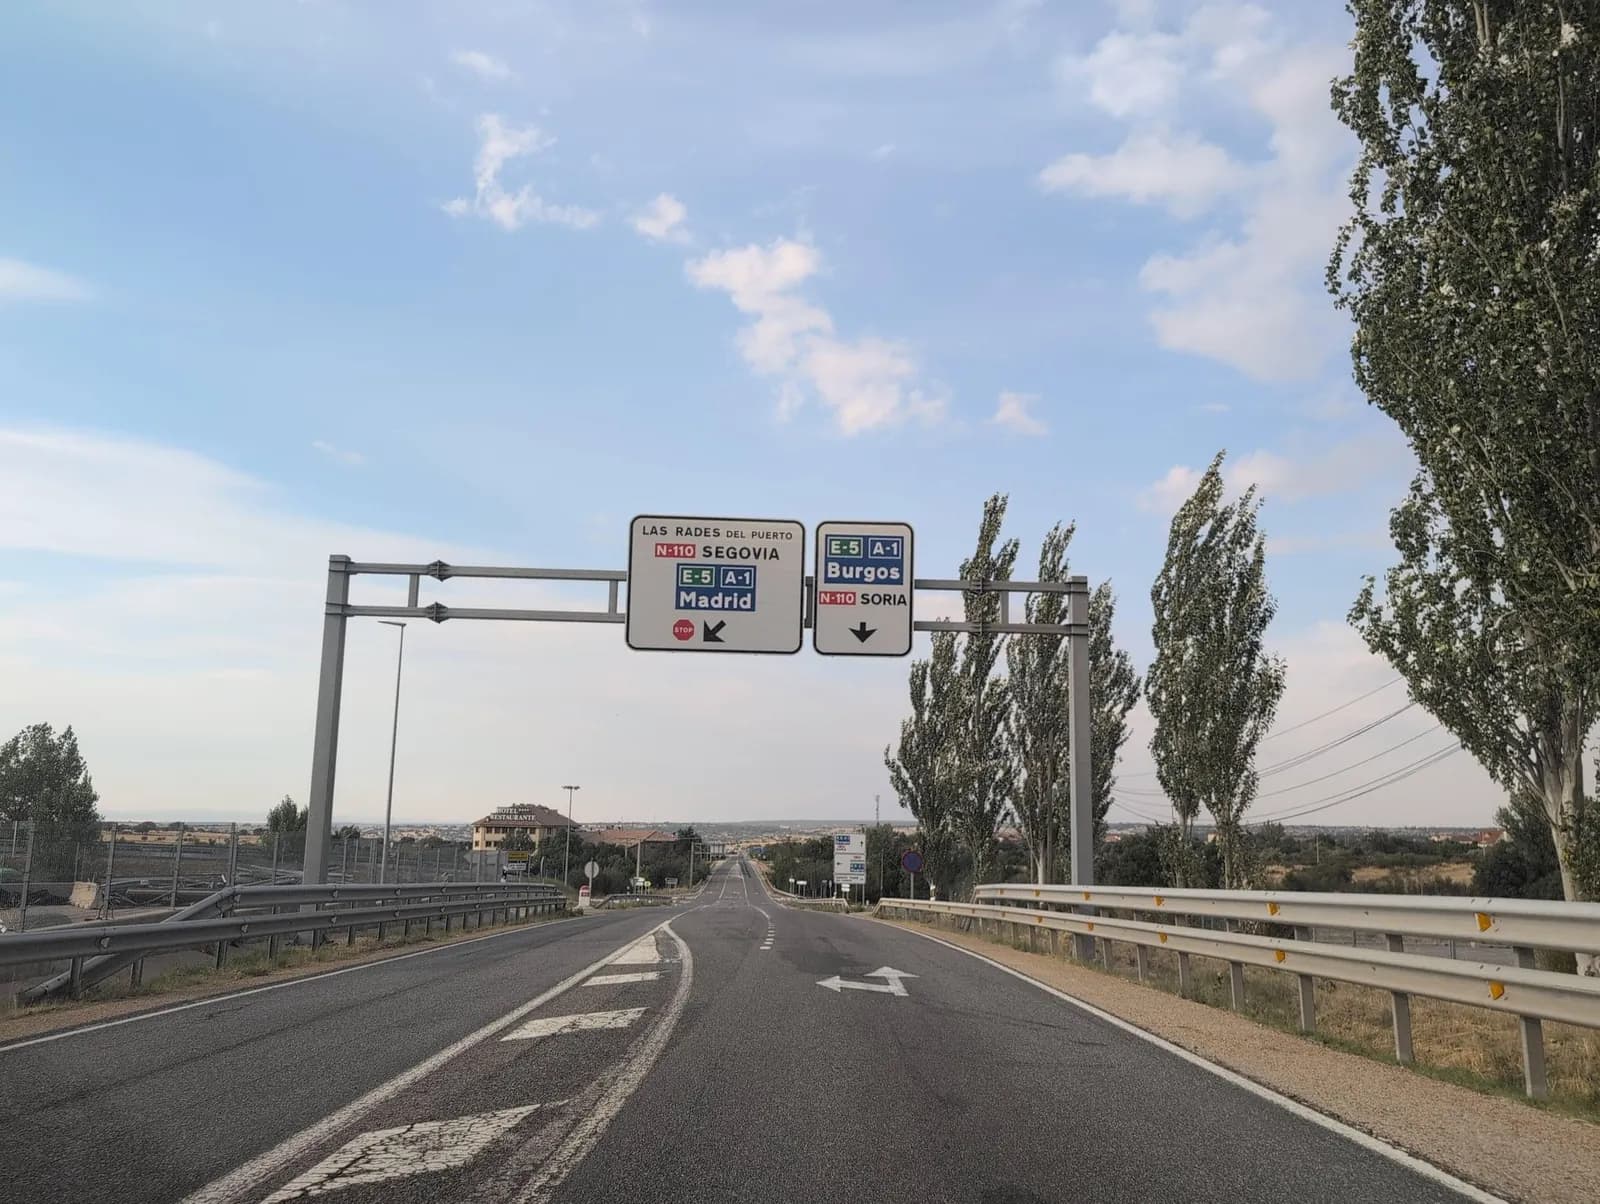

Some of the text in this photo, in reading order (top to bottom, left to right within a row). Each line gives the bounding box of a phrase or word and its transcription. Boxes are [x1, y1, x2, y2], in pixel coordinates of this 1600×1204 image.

[642, 525, 793, 540] LAS RADES DEL PUERTO
[656, 544, 780, 560] N-110 SEGOVIA
[831, 539, 898, 555] E-5 A-1
[682, 569, 751, 585] E-5 A-1
[827, 562, 900, 581] Burgos
[679, 591, 752, 609] Madrid
[820, 592, 907, 605] N-110 SORIA
